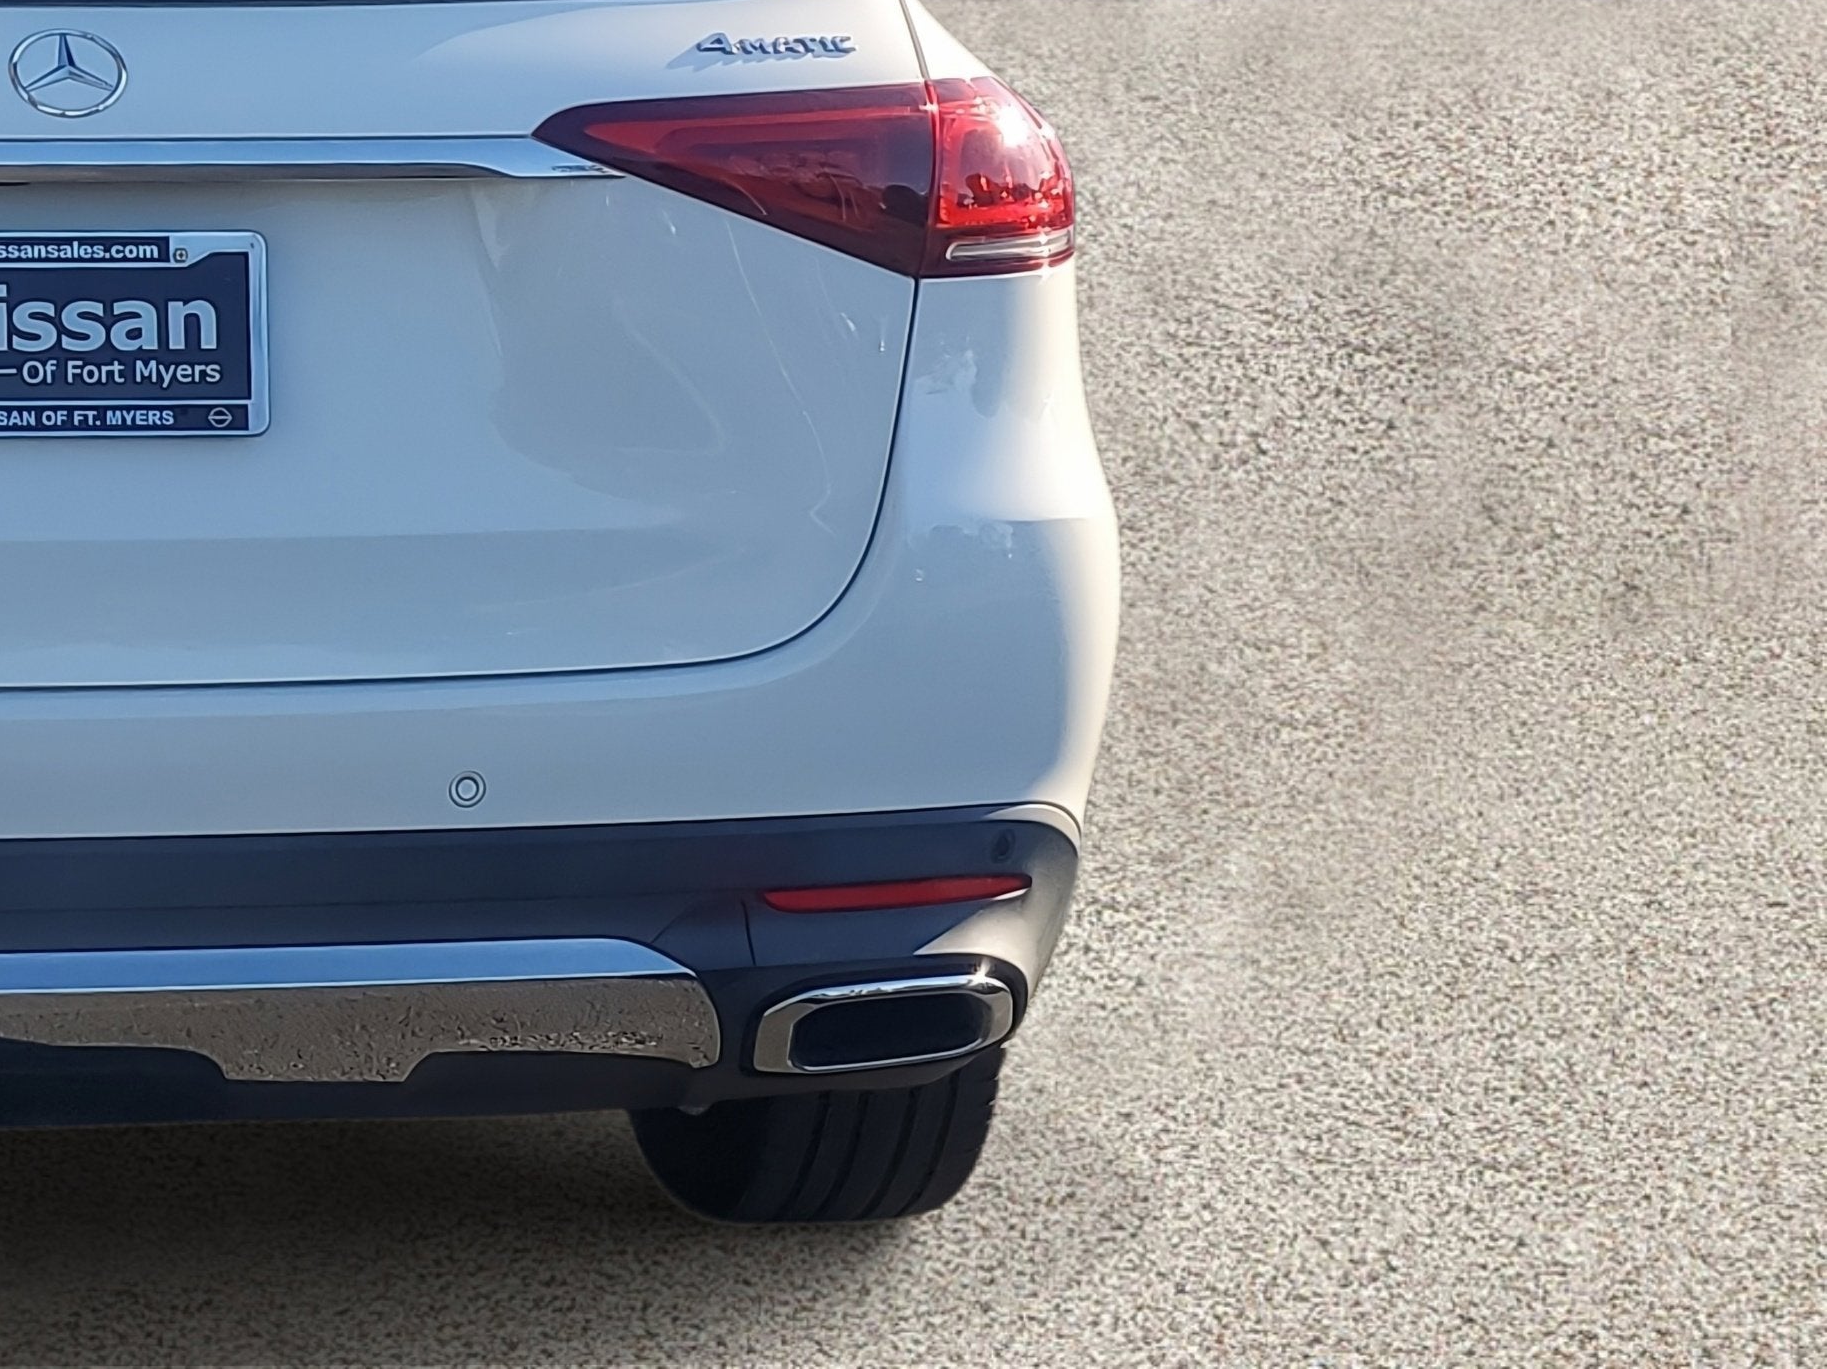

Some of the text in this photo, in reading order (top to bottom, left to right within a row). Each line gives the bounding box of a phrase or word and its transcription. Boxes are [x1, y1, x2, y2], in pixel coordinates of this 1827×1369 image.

[22, 360, 221, 389] Of Fort Myers
[42, 410, 68, 426] OF
[73, 410, 102, 426] FT.
[106, 409, 175, 426] MYERS
